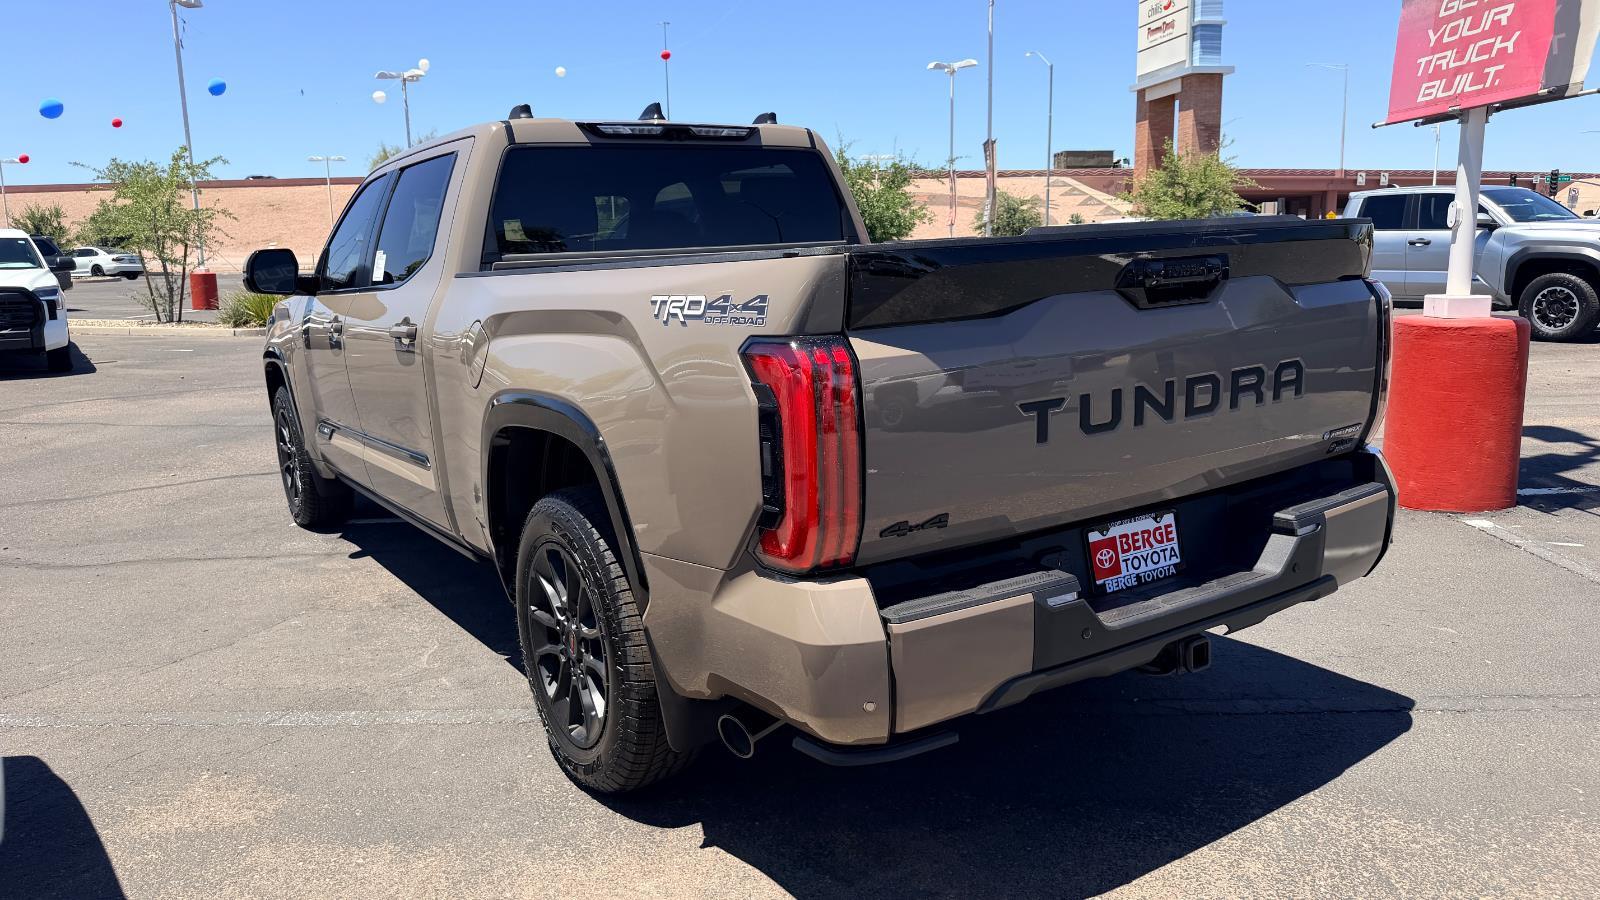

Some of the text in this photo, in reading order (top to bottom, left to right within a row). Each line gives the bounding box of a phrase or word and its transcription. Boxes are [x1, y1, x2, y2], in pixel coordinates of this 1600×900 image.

[1427, 3, 1515, 47] YOUR
[1417, 30, 1521, 76] TRUCK
[1417, 64, 1504, 103] BUILT.
[650, 295, 707, 327] TRD
[704, 316, 767, 327] OFF ROAD
[1015, 357, 1306, 444] TUNDRA
[1119, 523, 1175, 555] BERGE
[1121, 546, 1179, 573] TOYOTA
[1105, 565, 1177, 593] BERGE TOYOTA
